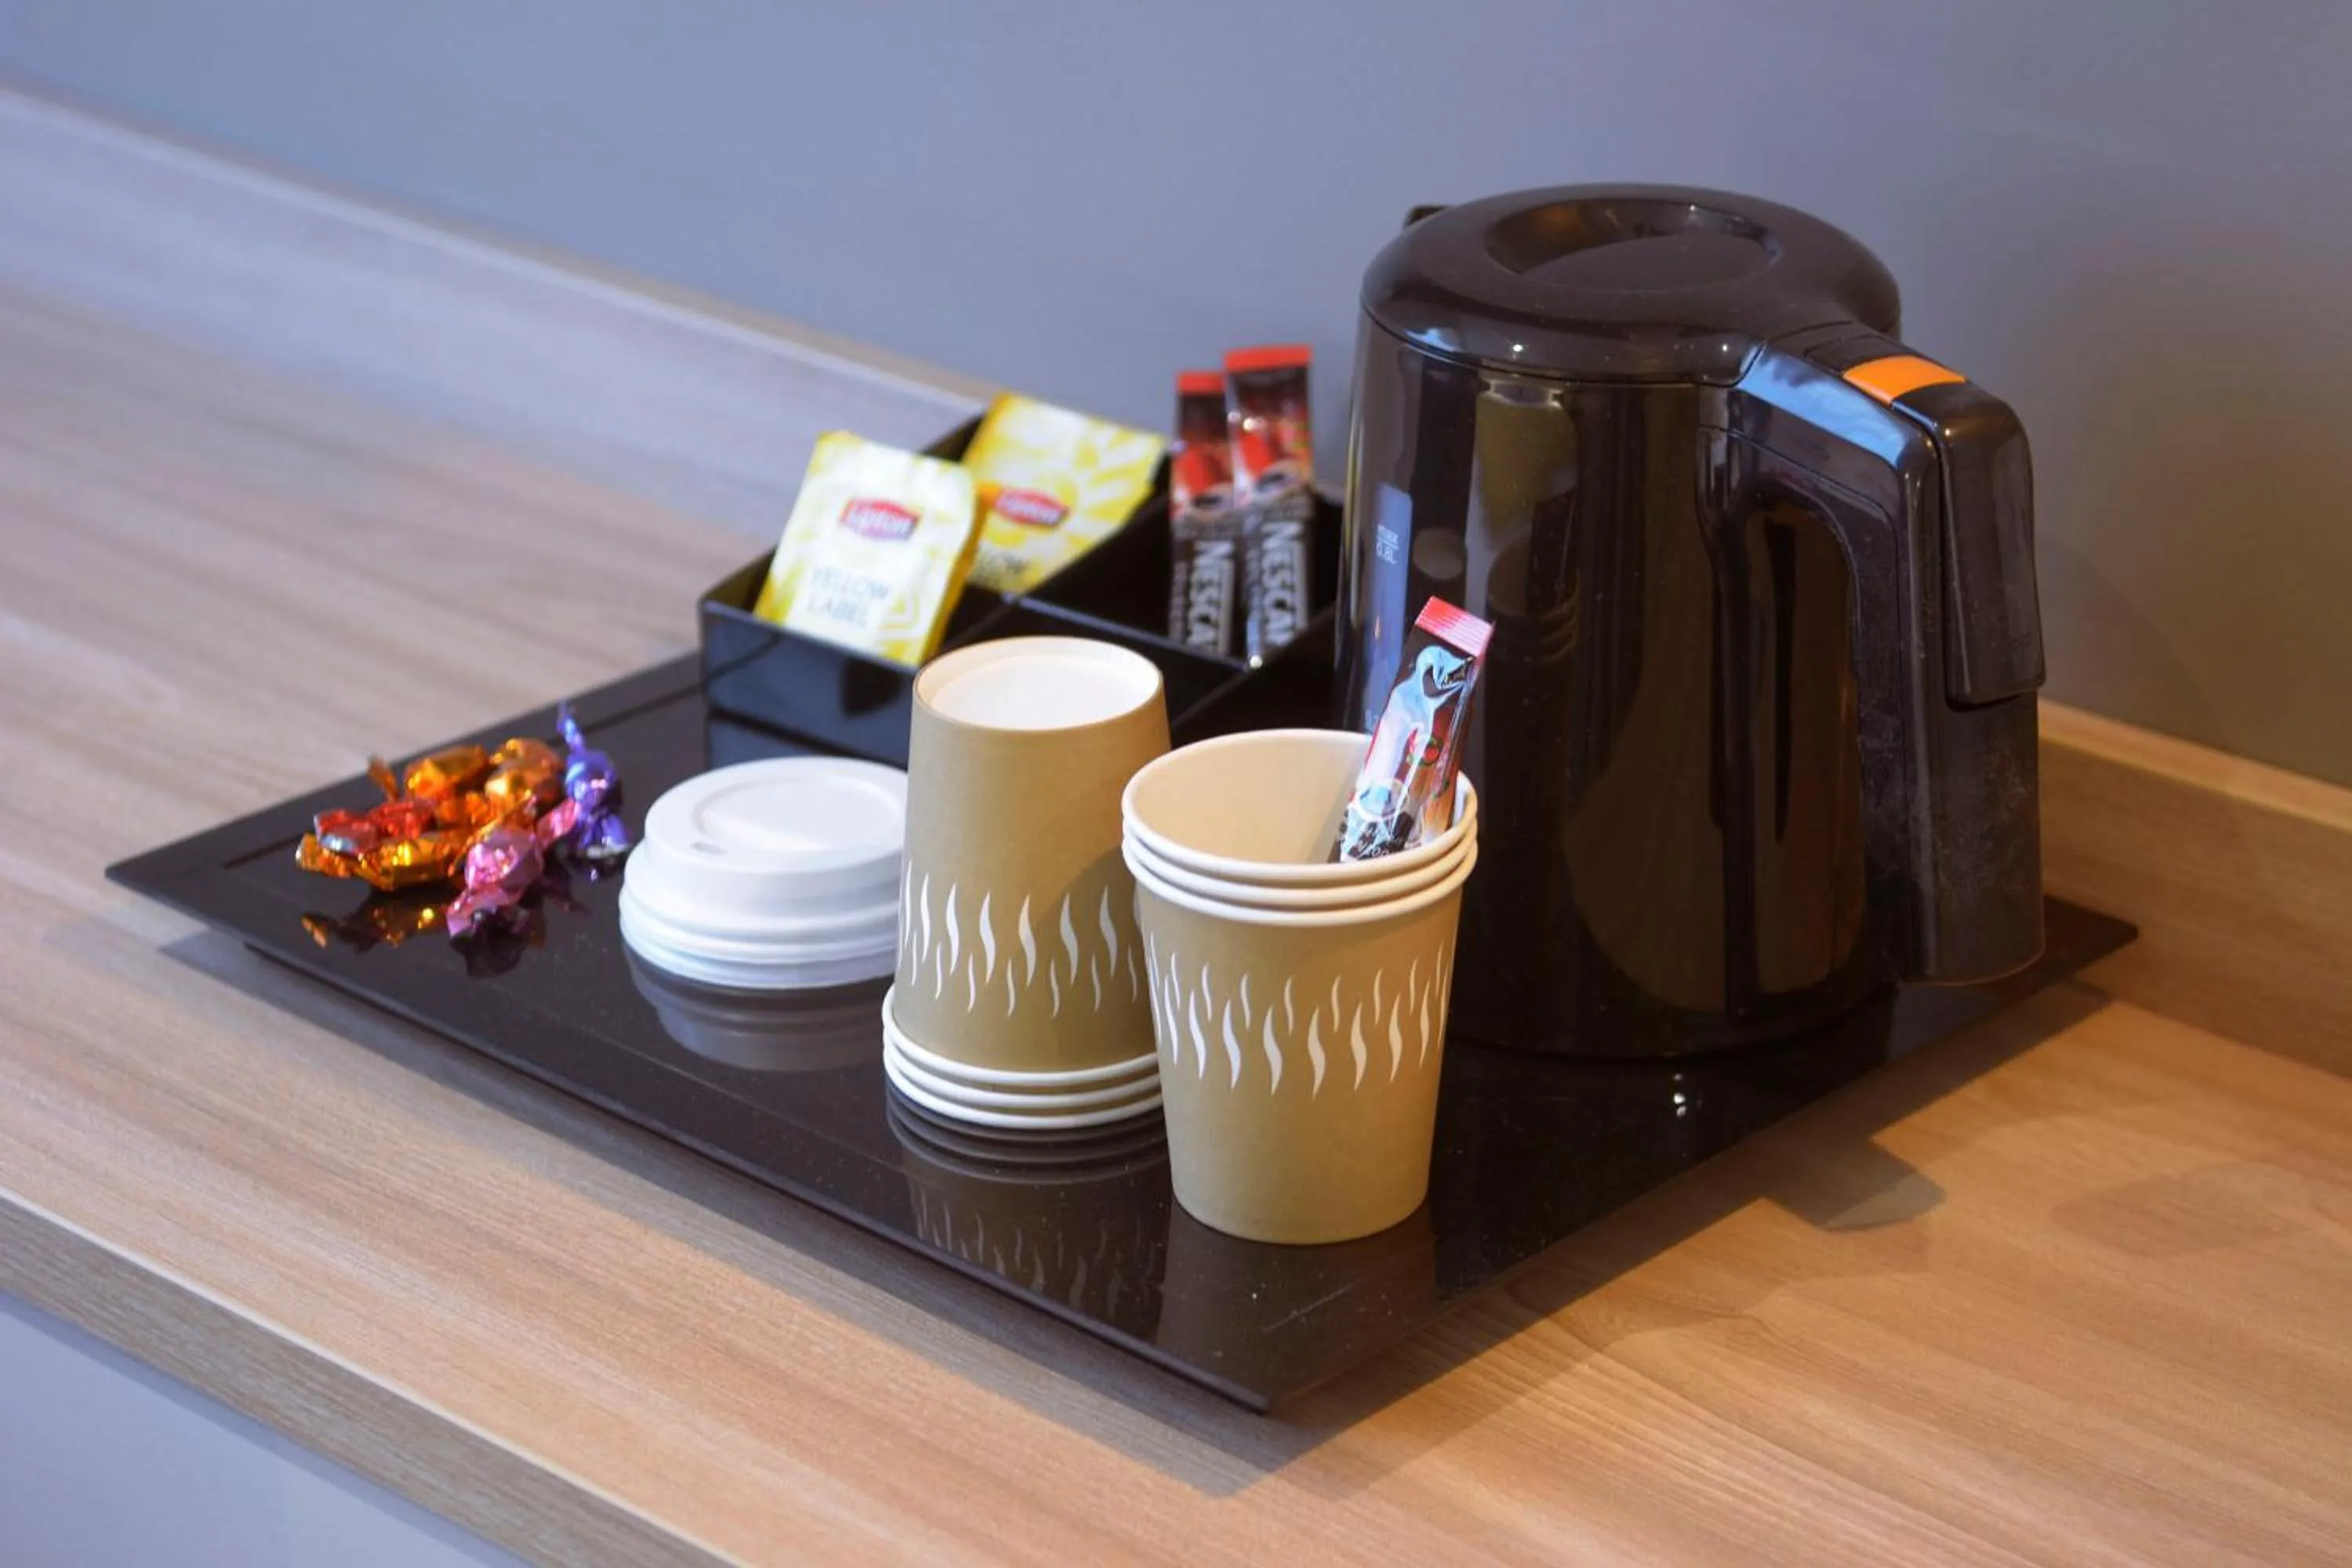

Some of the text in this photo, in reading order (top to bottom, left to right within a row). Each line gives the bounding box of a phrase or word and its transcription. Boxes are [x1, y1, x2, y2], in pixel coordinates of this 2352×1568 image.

[848, 503, 913, 536] Lipton
[811, 567, 890, 601] YELLOW
[807, 594, 869, 628] LABEL
